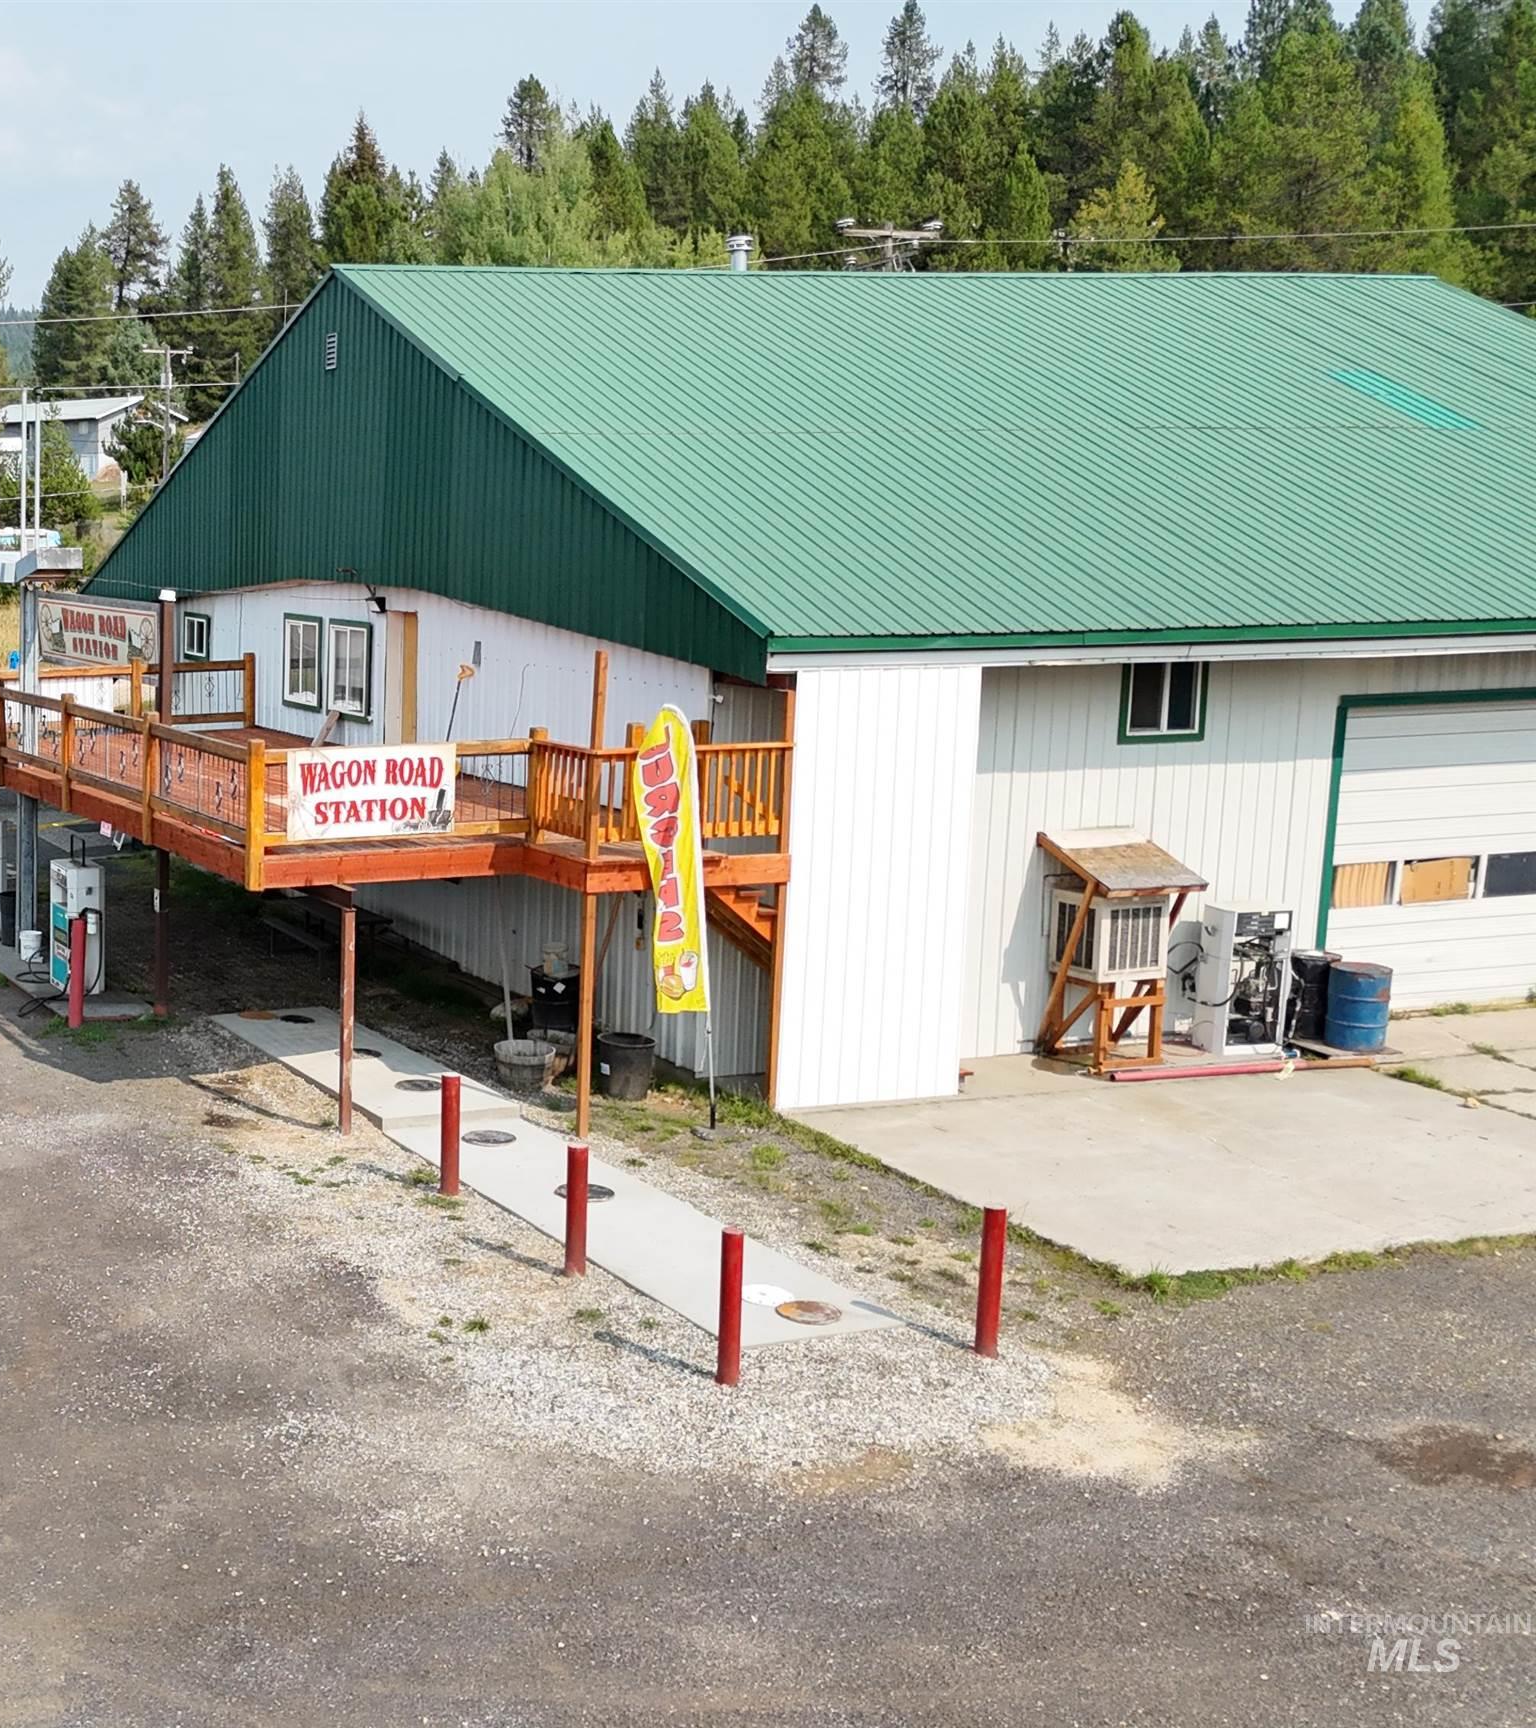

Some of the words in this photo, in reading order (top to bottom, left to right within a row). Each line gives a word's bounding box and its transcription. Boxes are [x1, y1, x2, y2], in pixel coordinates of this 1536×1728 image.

[61, 607, 95, 635] WAGON
[98, 615, 127, 643] ROAD
[72, 636, 118, 661] STATION
[299, 759, 376, 796] WAGON
[385, 757, 444, 789] ROAD
[315, 797, 427, 825] STATION
